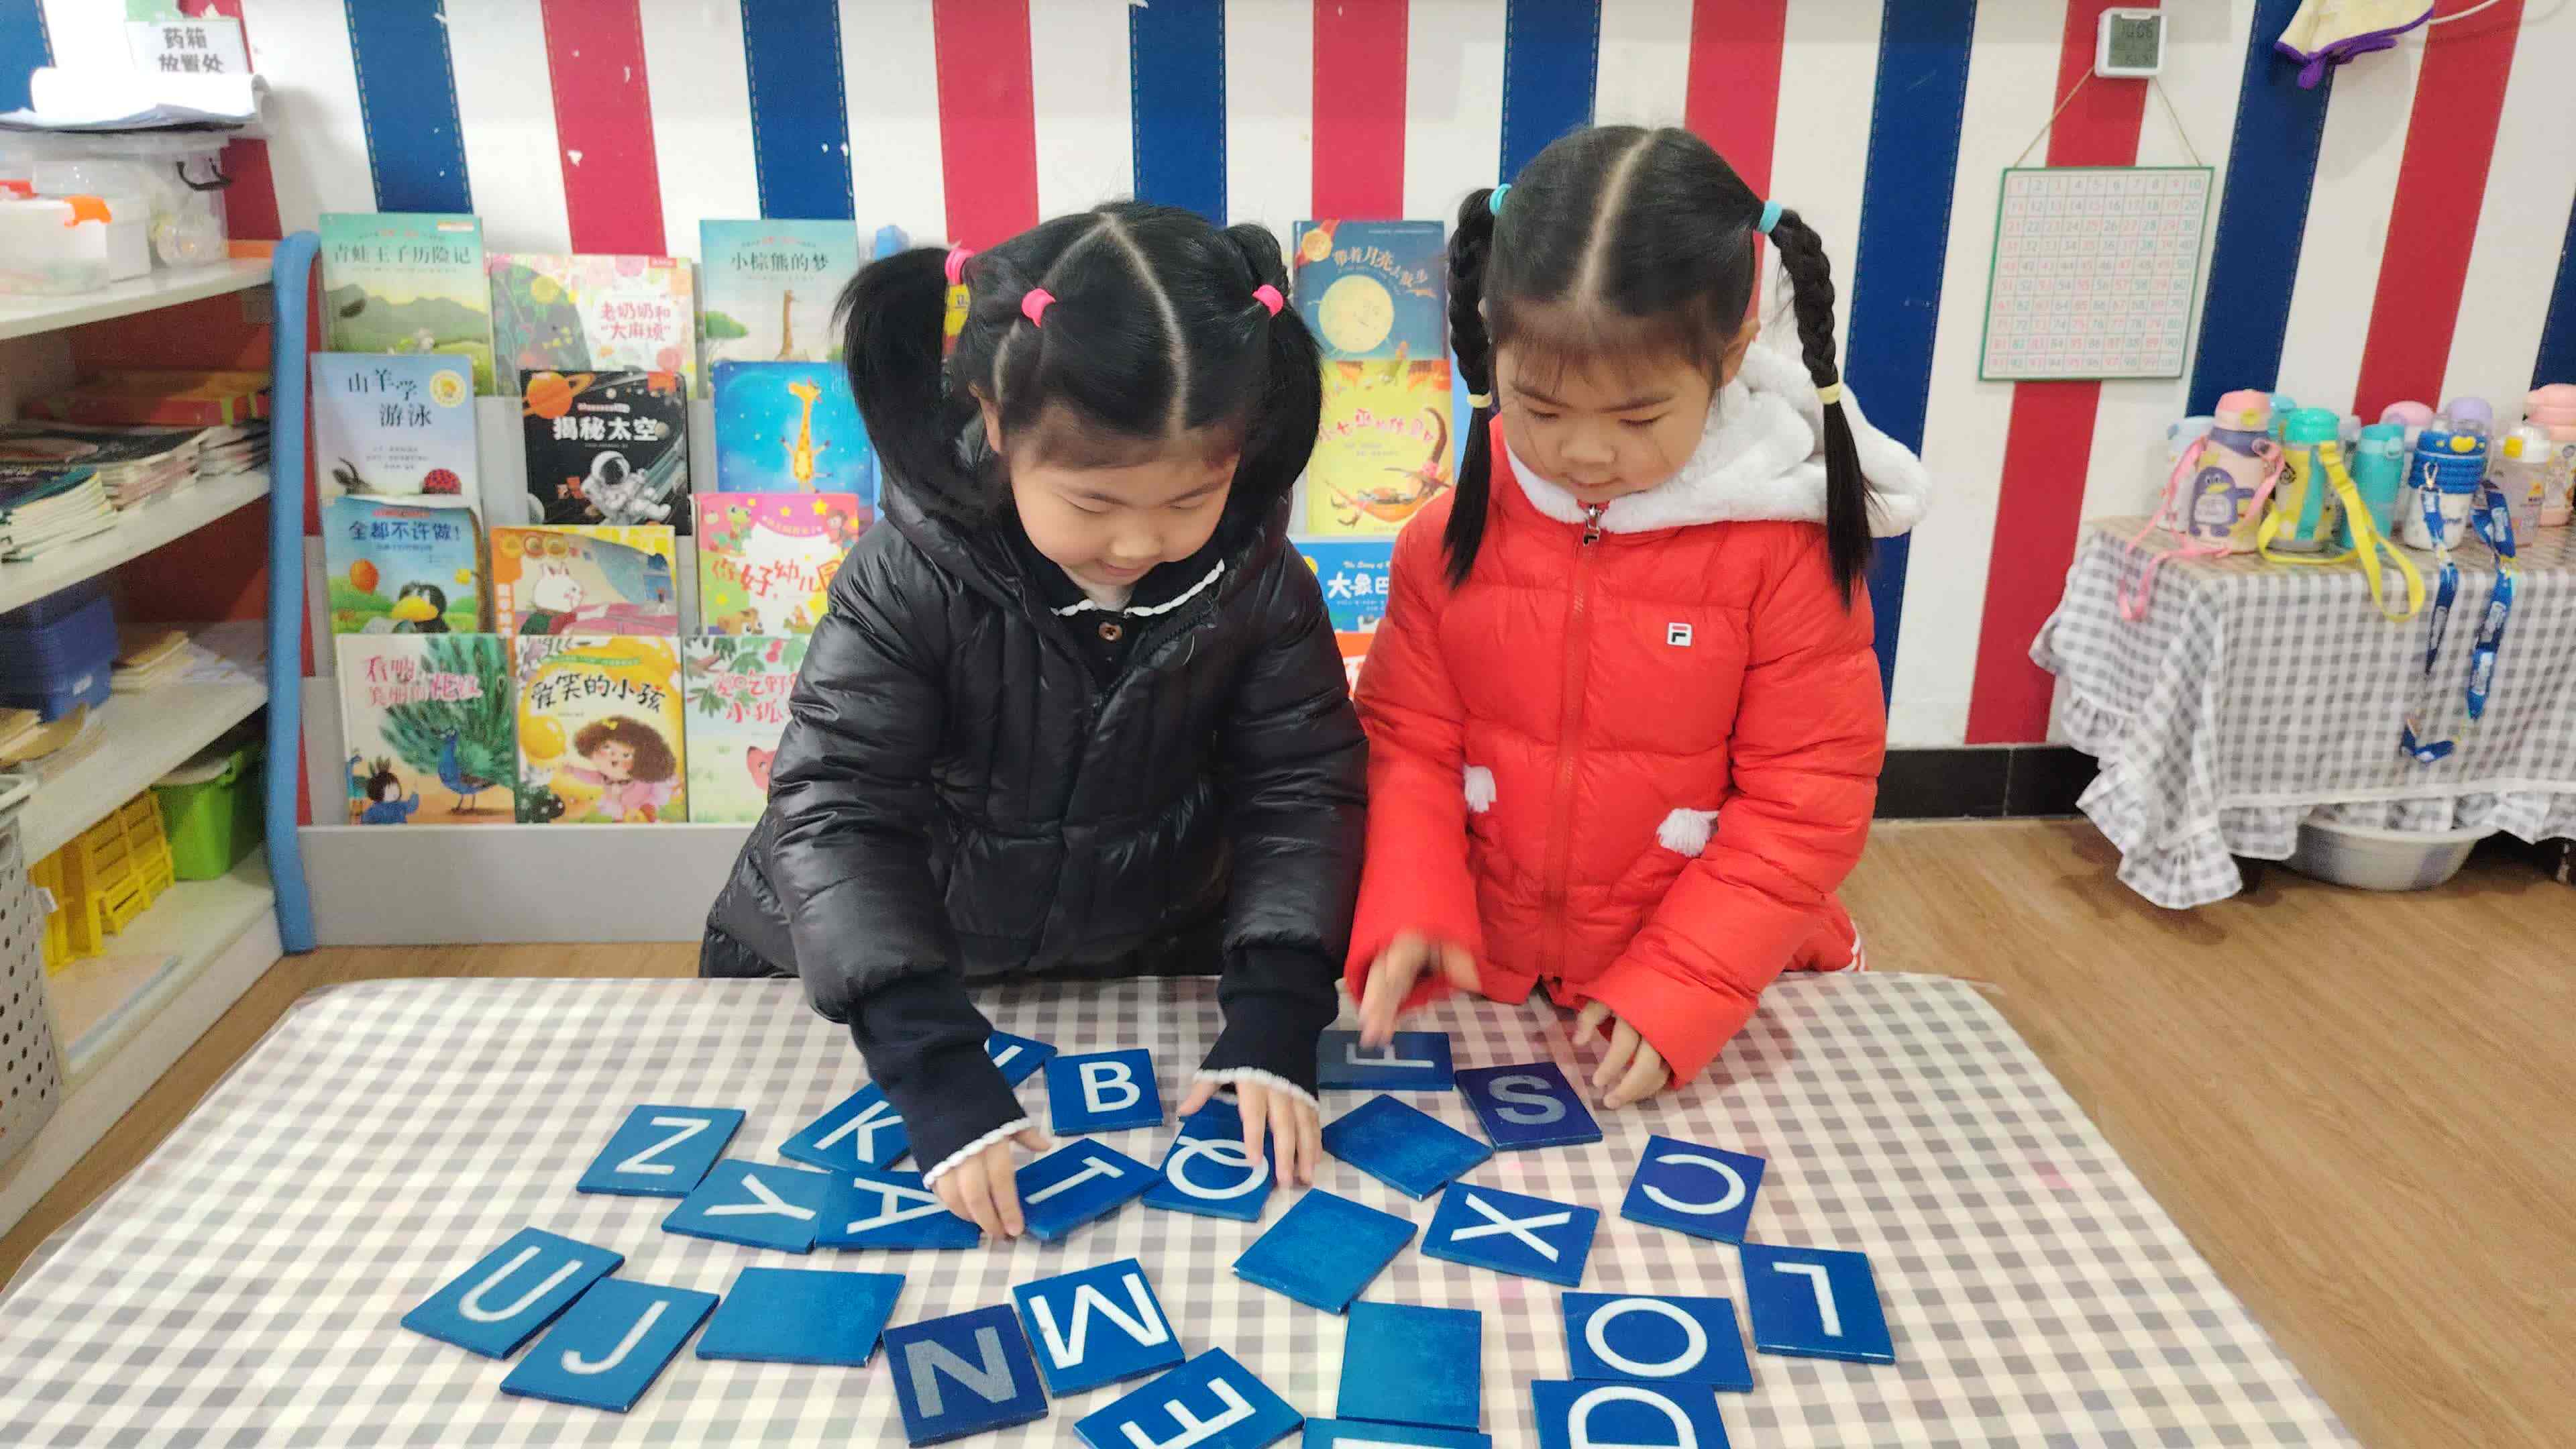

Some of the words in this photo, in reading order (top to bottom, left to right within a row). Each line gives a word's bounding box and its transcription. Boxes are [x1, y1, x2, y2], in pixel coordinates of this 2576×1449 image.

[163, 27, 207, 49] 药箱
[158, 54, 225, 74] 放置处
[334, 241, 471, 264] 青蛙王子历险记
[731, 250, 828, 272] 小棕熊的梦
[601, 301, 671, 321] 老奶奶和
[348, 368, 418, 401] 山羊学
[379, 403, 431, 427] 游泳
[552, 416, 658, 442] 揭秘太空
[726, 698, 792, 724] 小狐
[1080, 1062, 1140, 1112] B
[1488, 1075, 1566, 1124] S
[814, 1101, 902, 1163] K
[1026, 1157, 1124, 1205] T
[1167, 1136, 1269, 1199] Q
[1642, 1154, 1747, 1215] C
[703, 1173, 816, 1221] Y
[847, 1178, 963, 1234] A
[1450, 1193, 1571, 1263] X
[458, 1245, 584, 1323] U
[1772, 1262, 1843, 1337] L
[561, 1300, 669, 1375] J
[1585, 1298, 1707, 1377] O
[904, 1326, 1017, 1418] N
[1120, 1378, 1256, 1449] E
[1568, 1386, 1699, 1449] D
